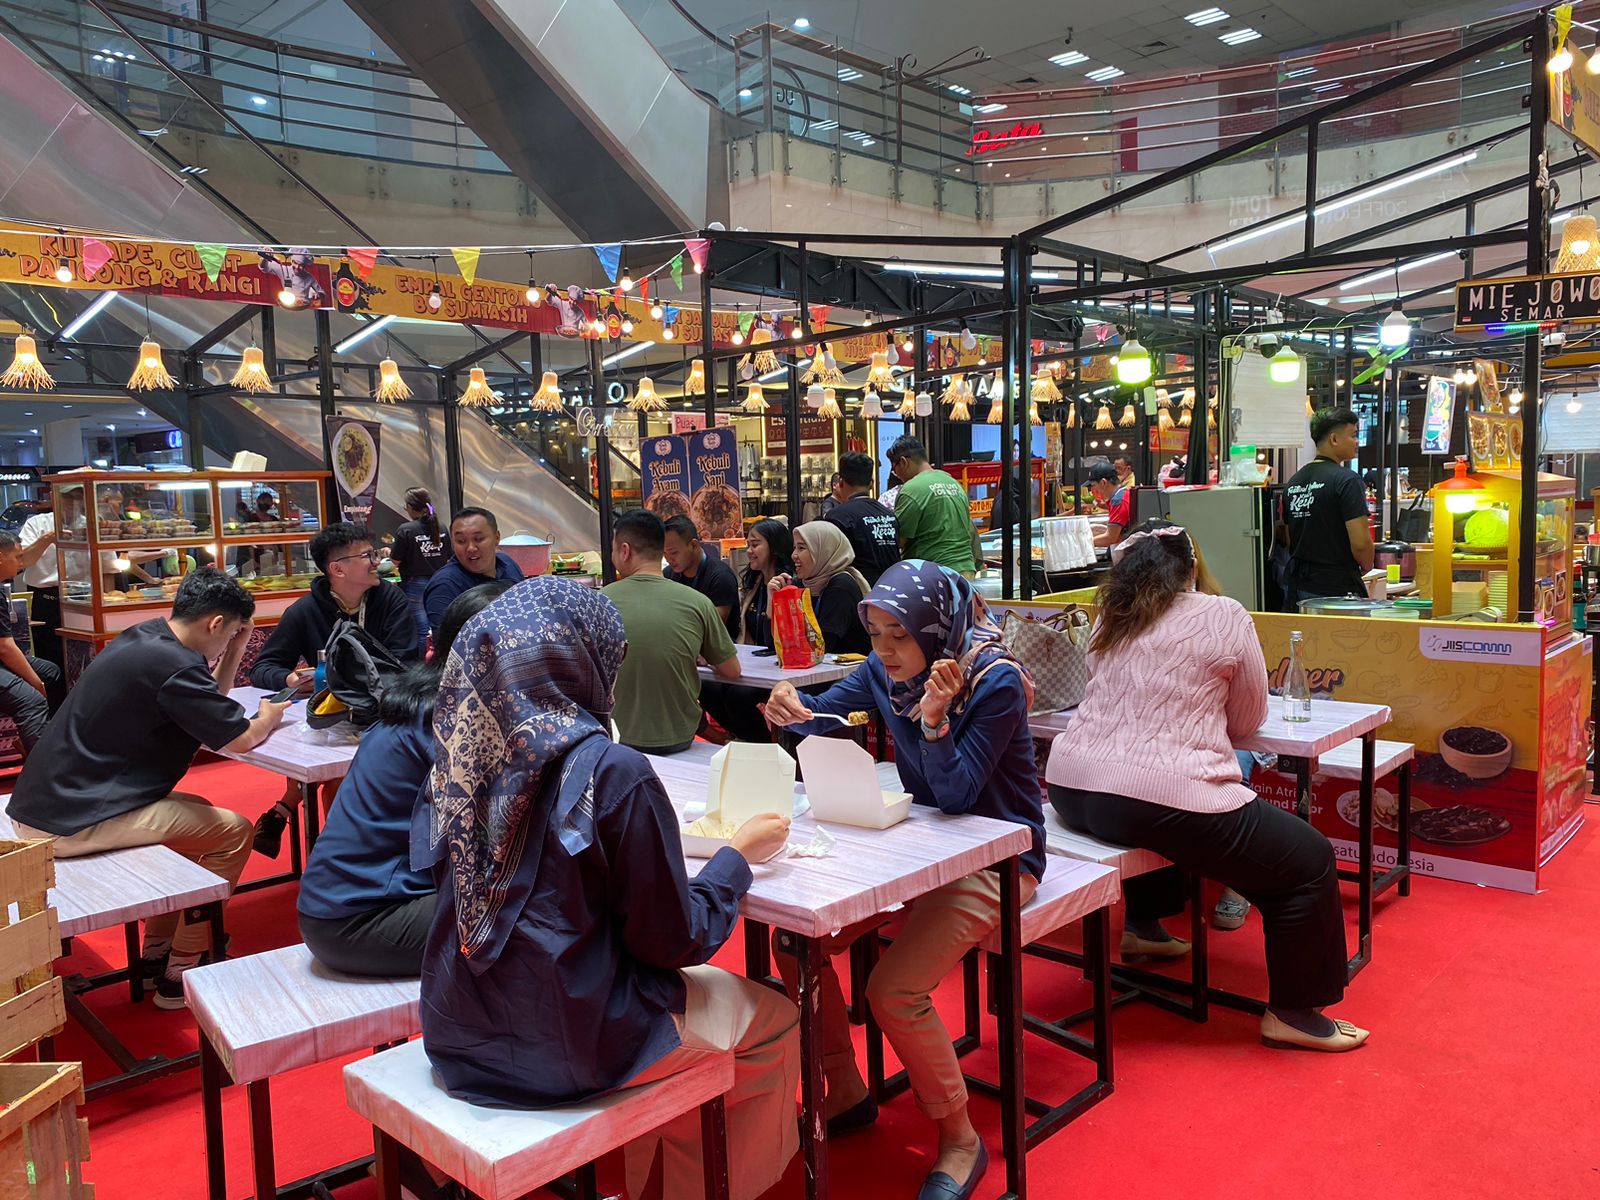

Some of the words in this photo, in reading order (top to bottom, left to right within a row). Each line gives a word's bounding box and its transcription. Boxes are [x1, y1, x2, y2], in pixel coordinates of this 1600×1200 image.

[160, 268, 179, 288] &
[186, 270, 262, 296] RANGI
[1469, 284, 1515, 311] MIE
[1527, 275, 1600, 306] JOWO
[444, 299, 528, 324] SUMIASIH
[1500, 304, 1565, 322] SEMAR
[648, 458, 681, 480] Kebuli
[696, 452, 731, 475] Kebuli
[703, 470, 726, 489] Sapi
